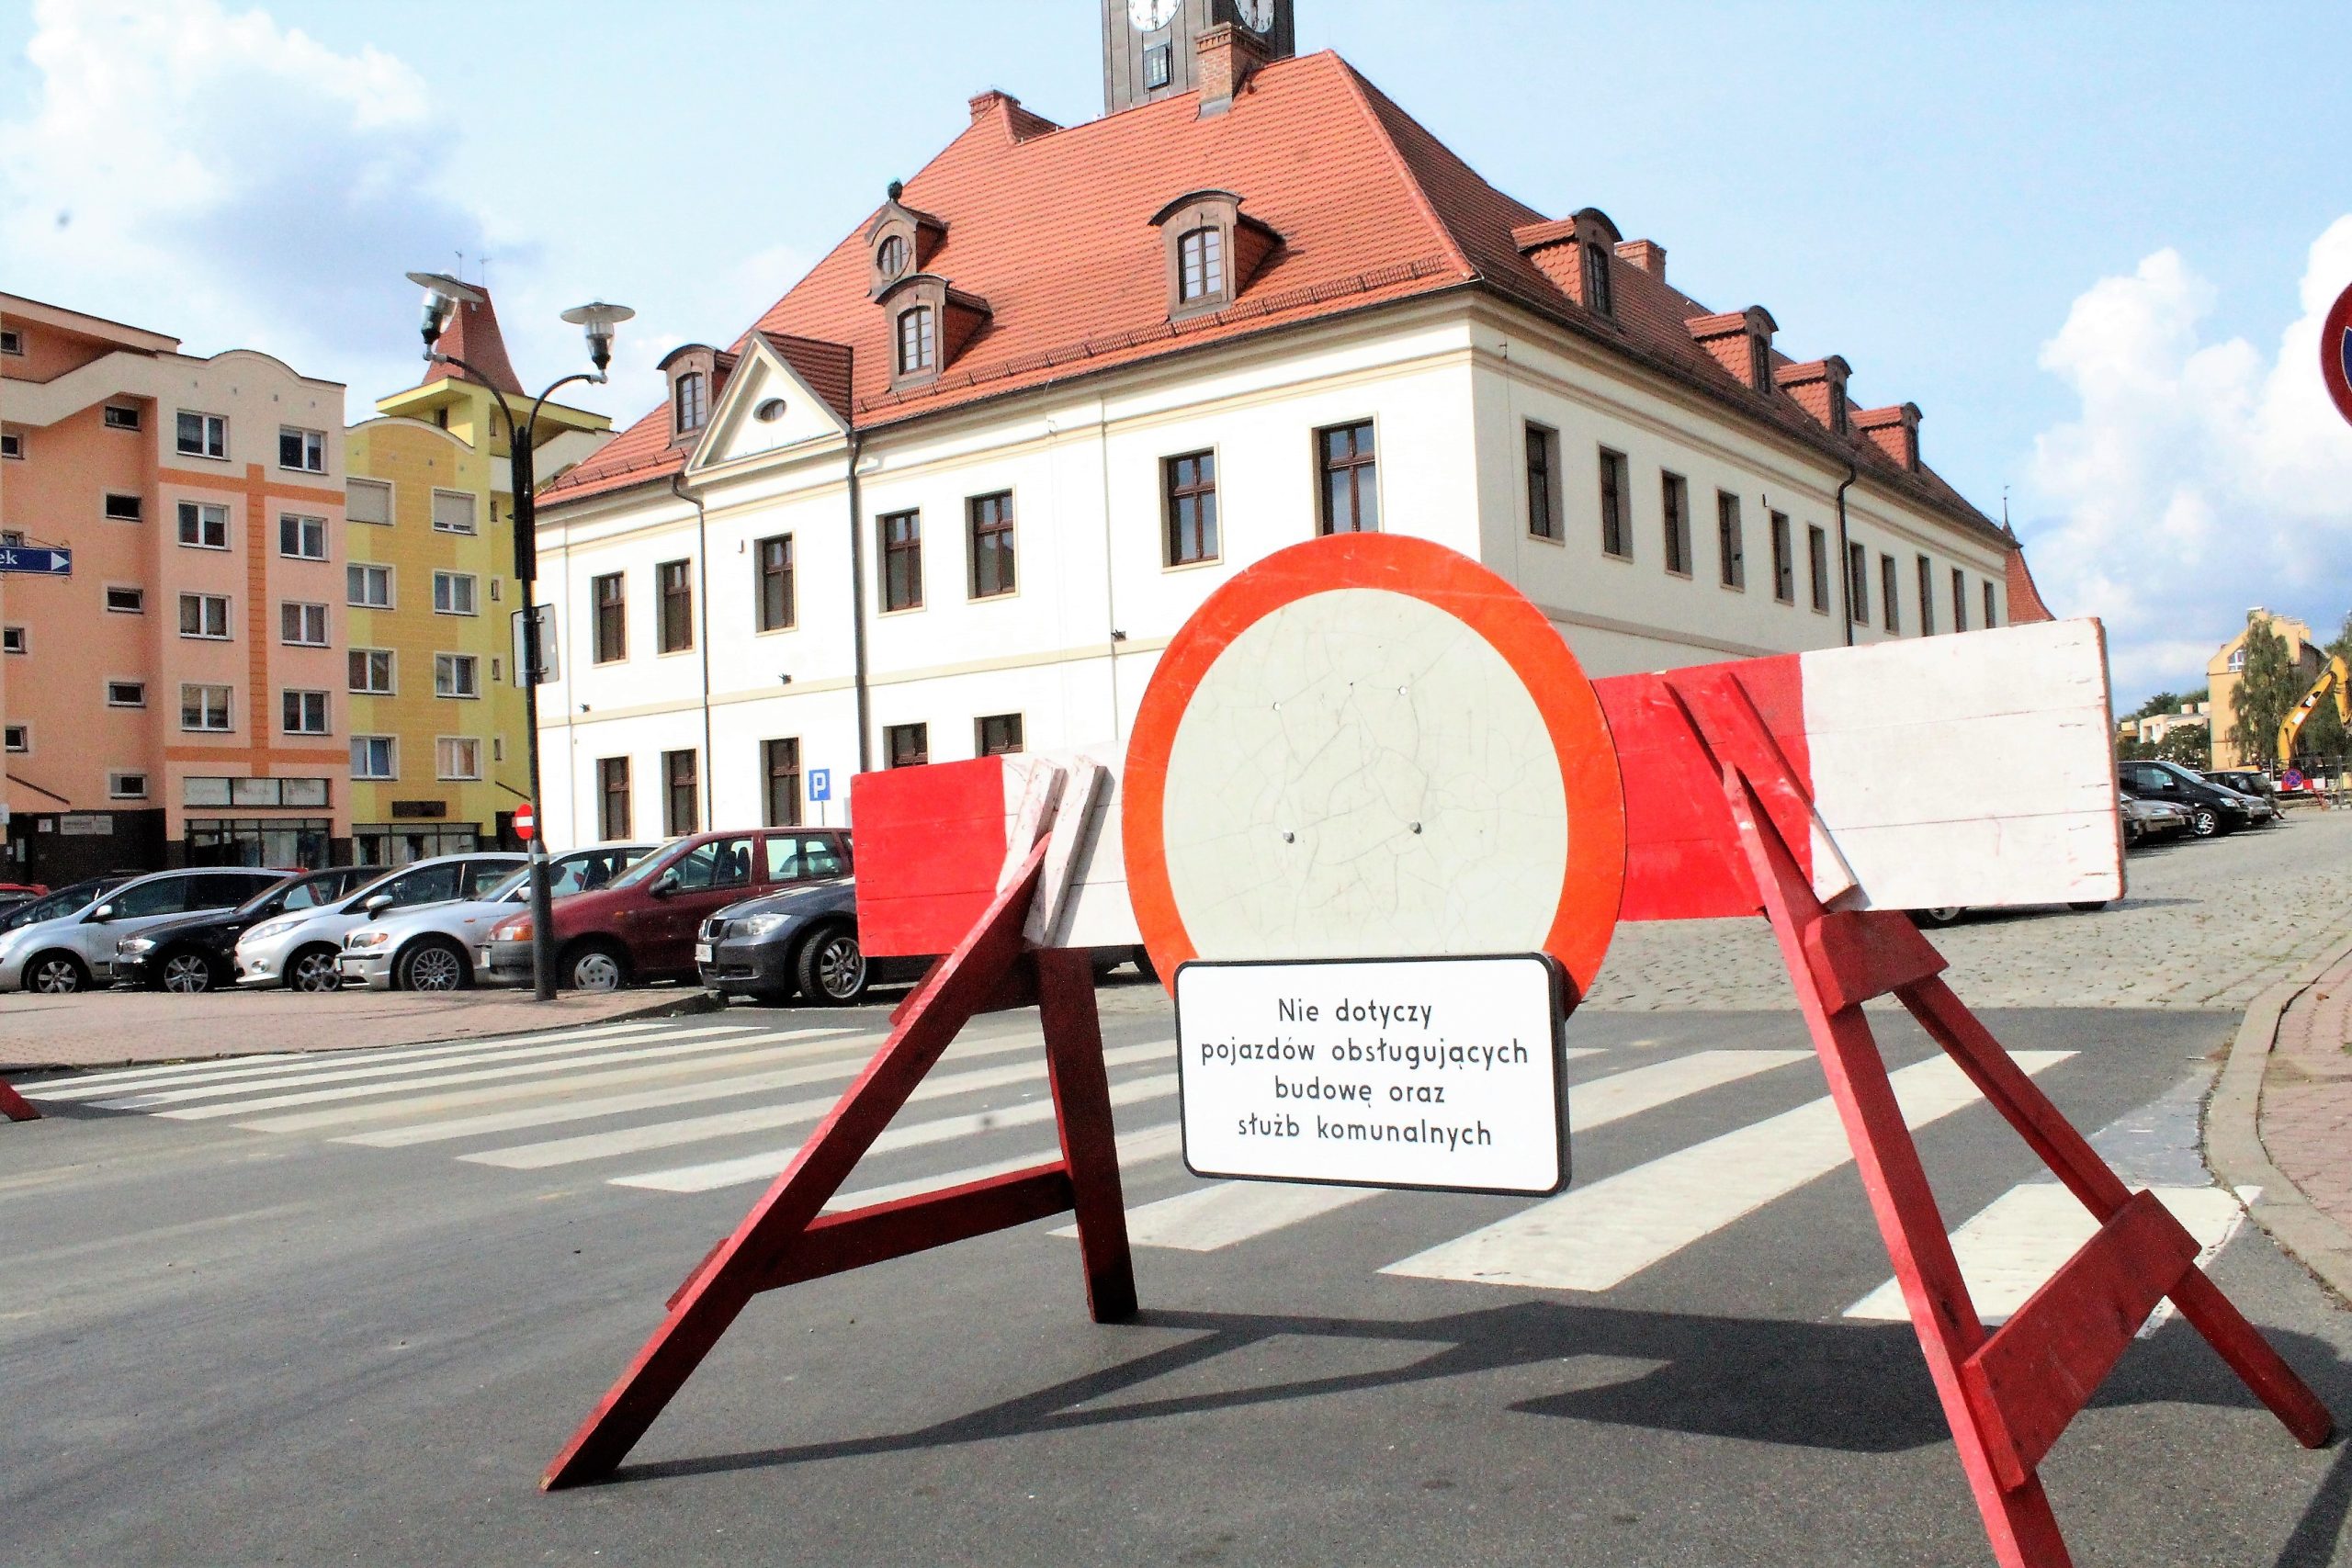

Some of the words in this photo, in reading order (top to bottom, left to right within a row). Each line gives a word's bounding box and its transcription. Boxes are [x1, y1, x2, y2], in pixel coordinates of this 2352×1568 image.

[813, 772, 827, 799] P
[1278, 998, 1319, 1022] Nie
[1335, 998, 1432, 1030] dotyczy
[1201, 1036, 1315, 1066] pojazdów
[1331, 1037, 1528, 1072] obsługujących
[1275, 1075, 1373, 1109] budowę
[1389, 1085, 1445, 1103] oraz
[1238, 1112, 1300, 1138] służb
[1317, 1115, 1492, 1153] komunalnych
